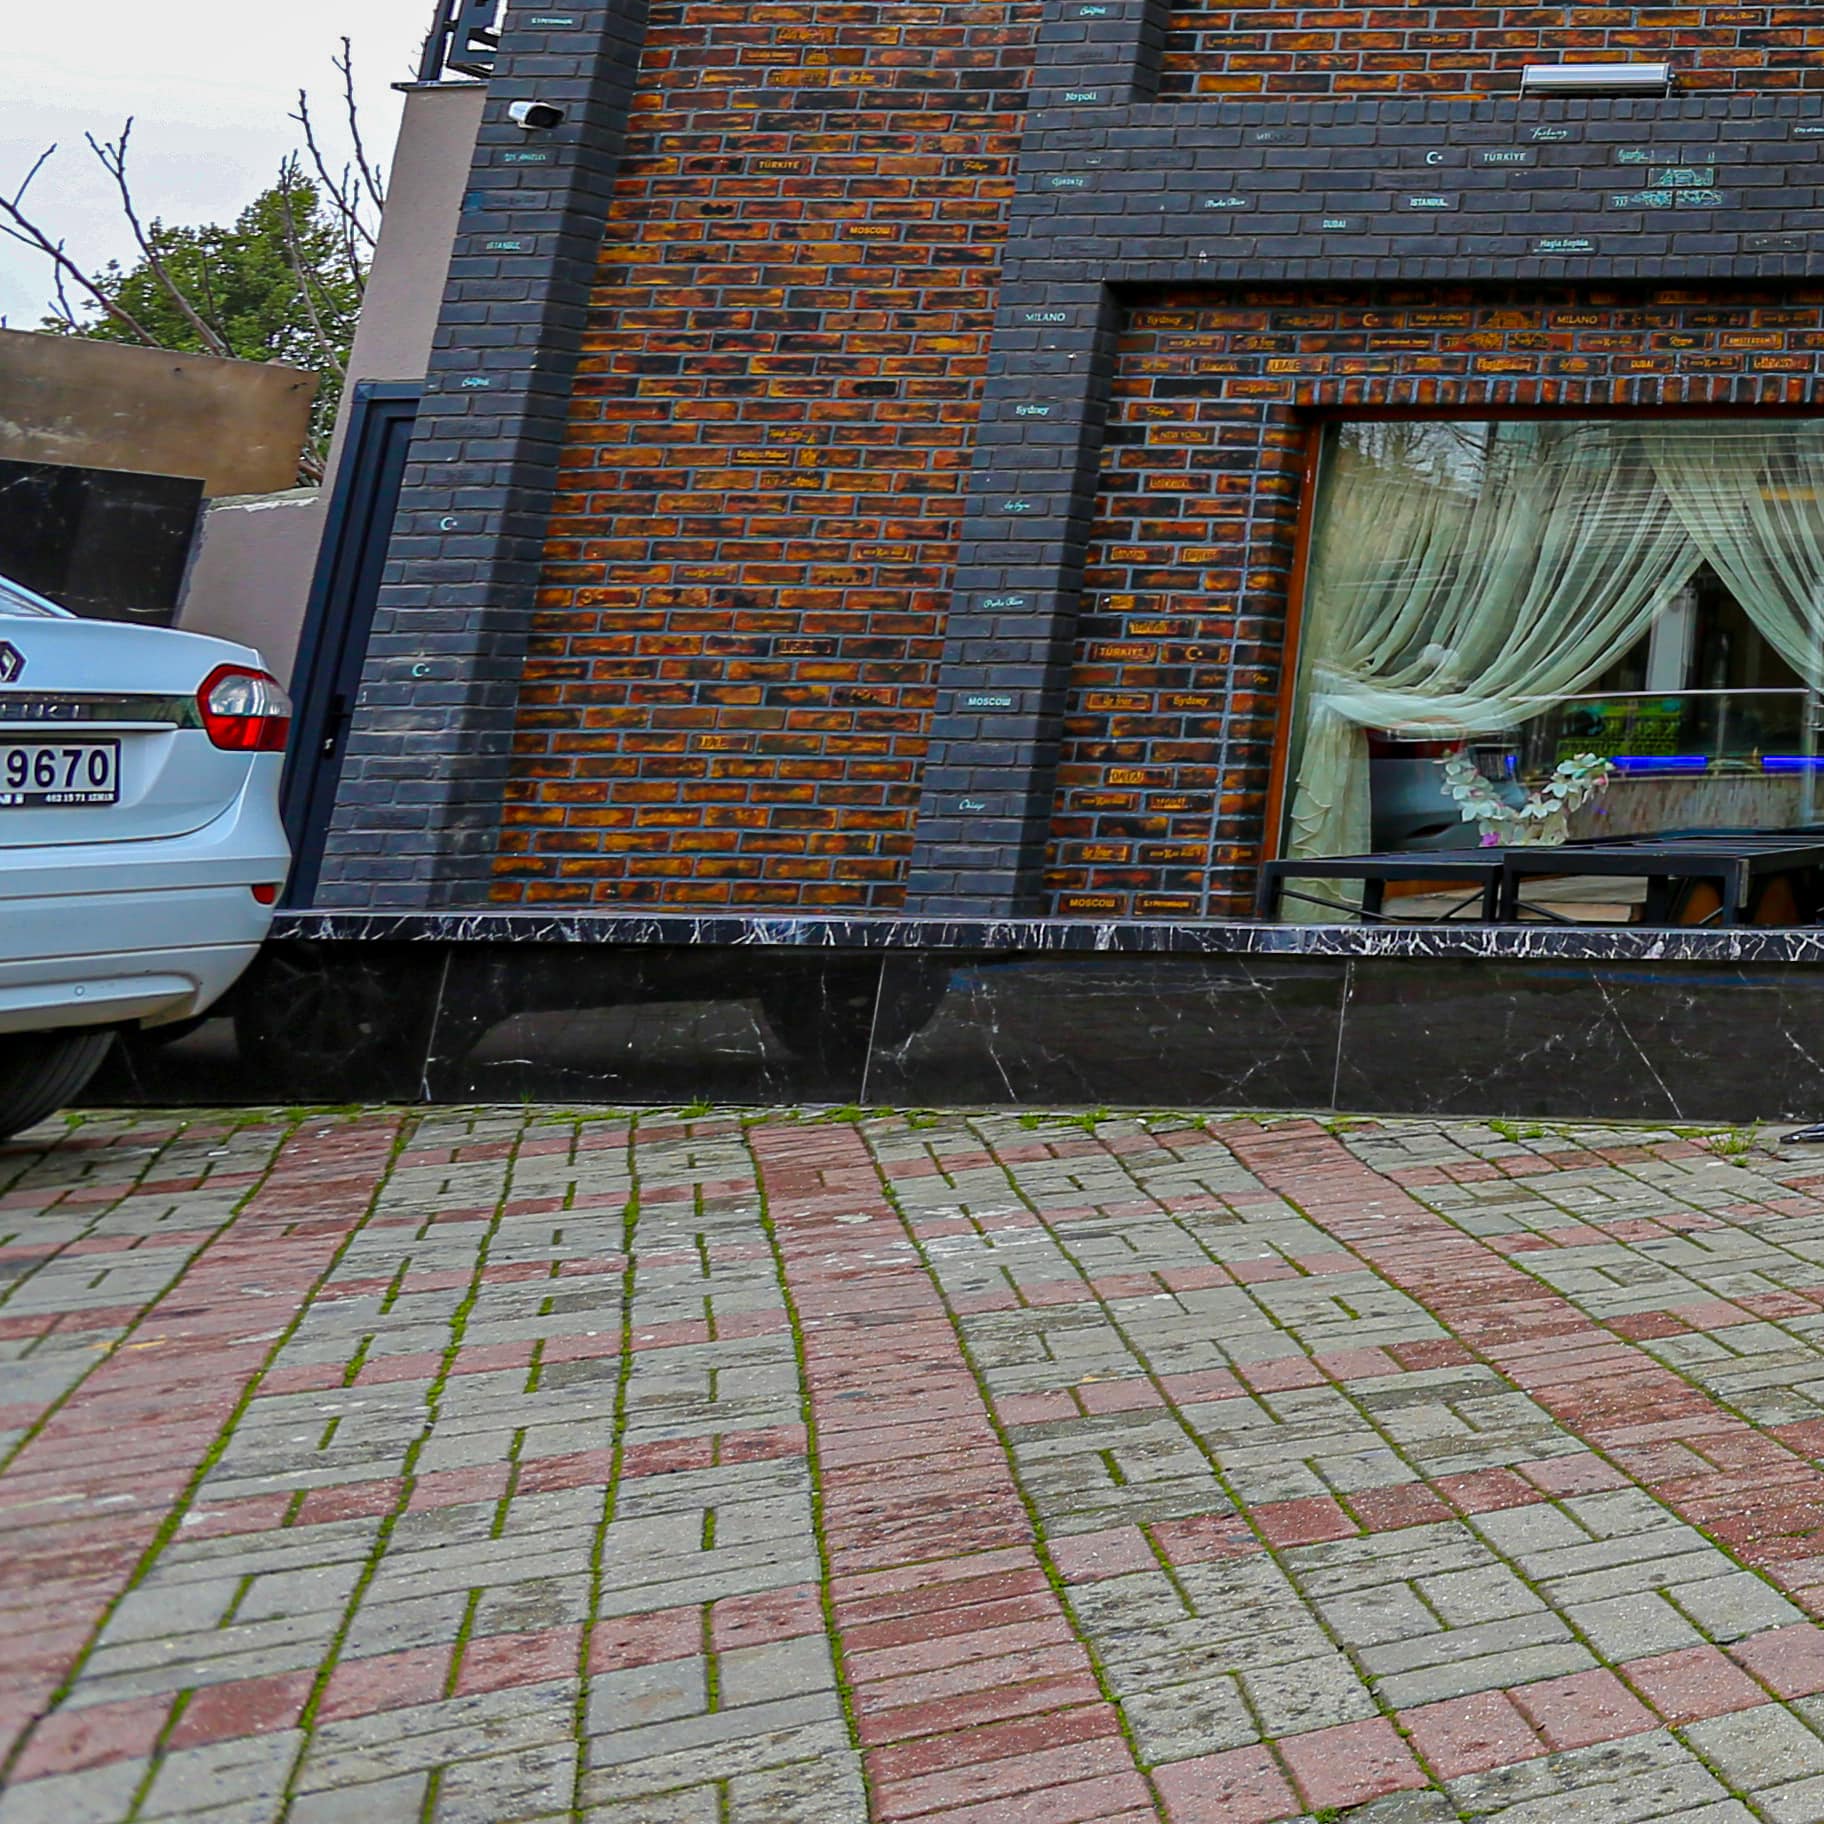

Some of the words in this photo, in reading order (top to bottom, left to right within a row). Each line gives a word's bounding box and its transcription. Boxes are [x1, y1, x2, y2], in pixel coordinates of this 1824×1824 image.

[1024, 312, 1066, 321] MILANO
[1556, 314, 1597, 324] MILANO
[1015, 404, 1050, 416] Sydney
[1173, 696, 1209, 707] Sydney
[6, 749, 109, 788] 9670
